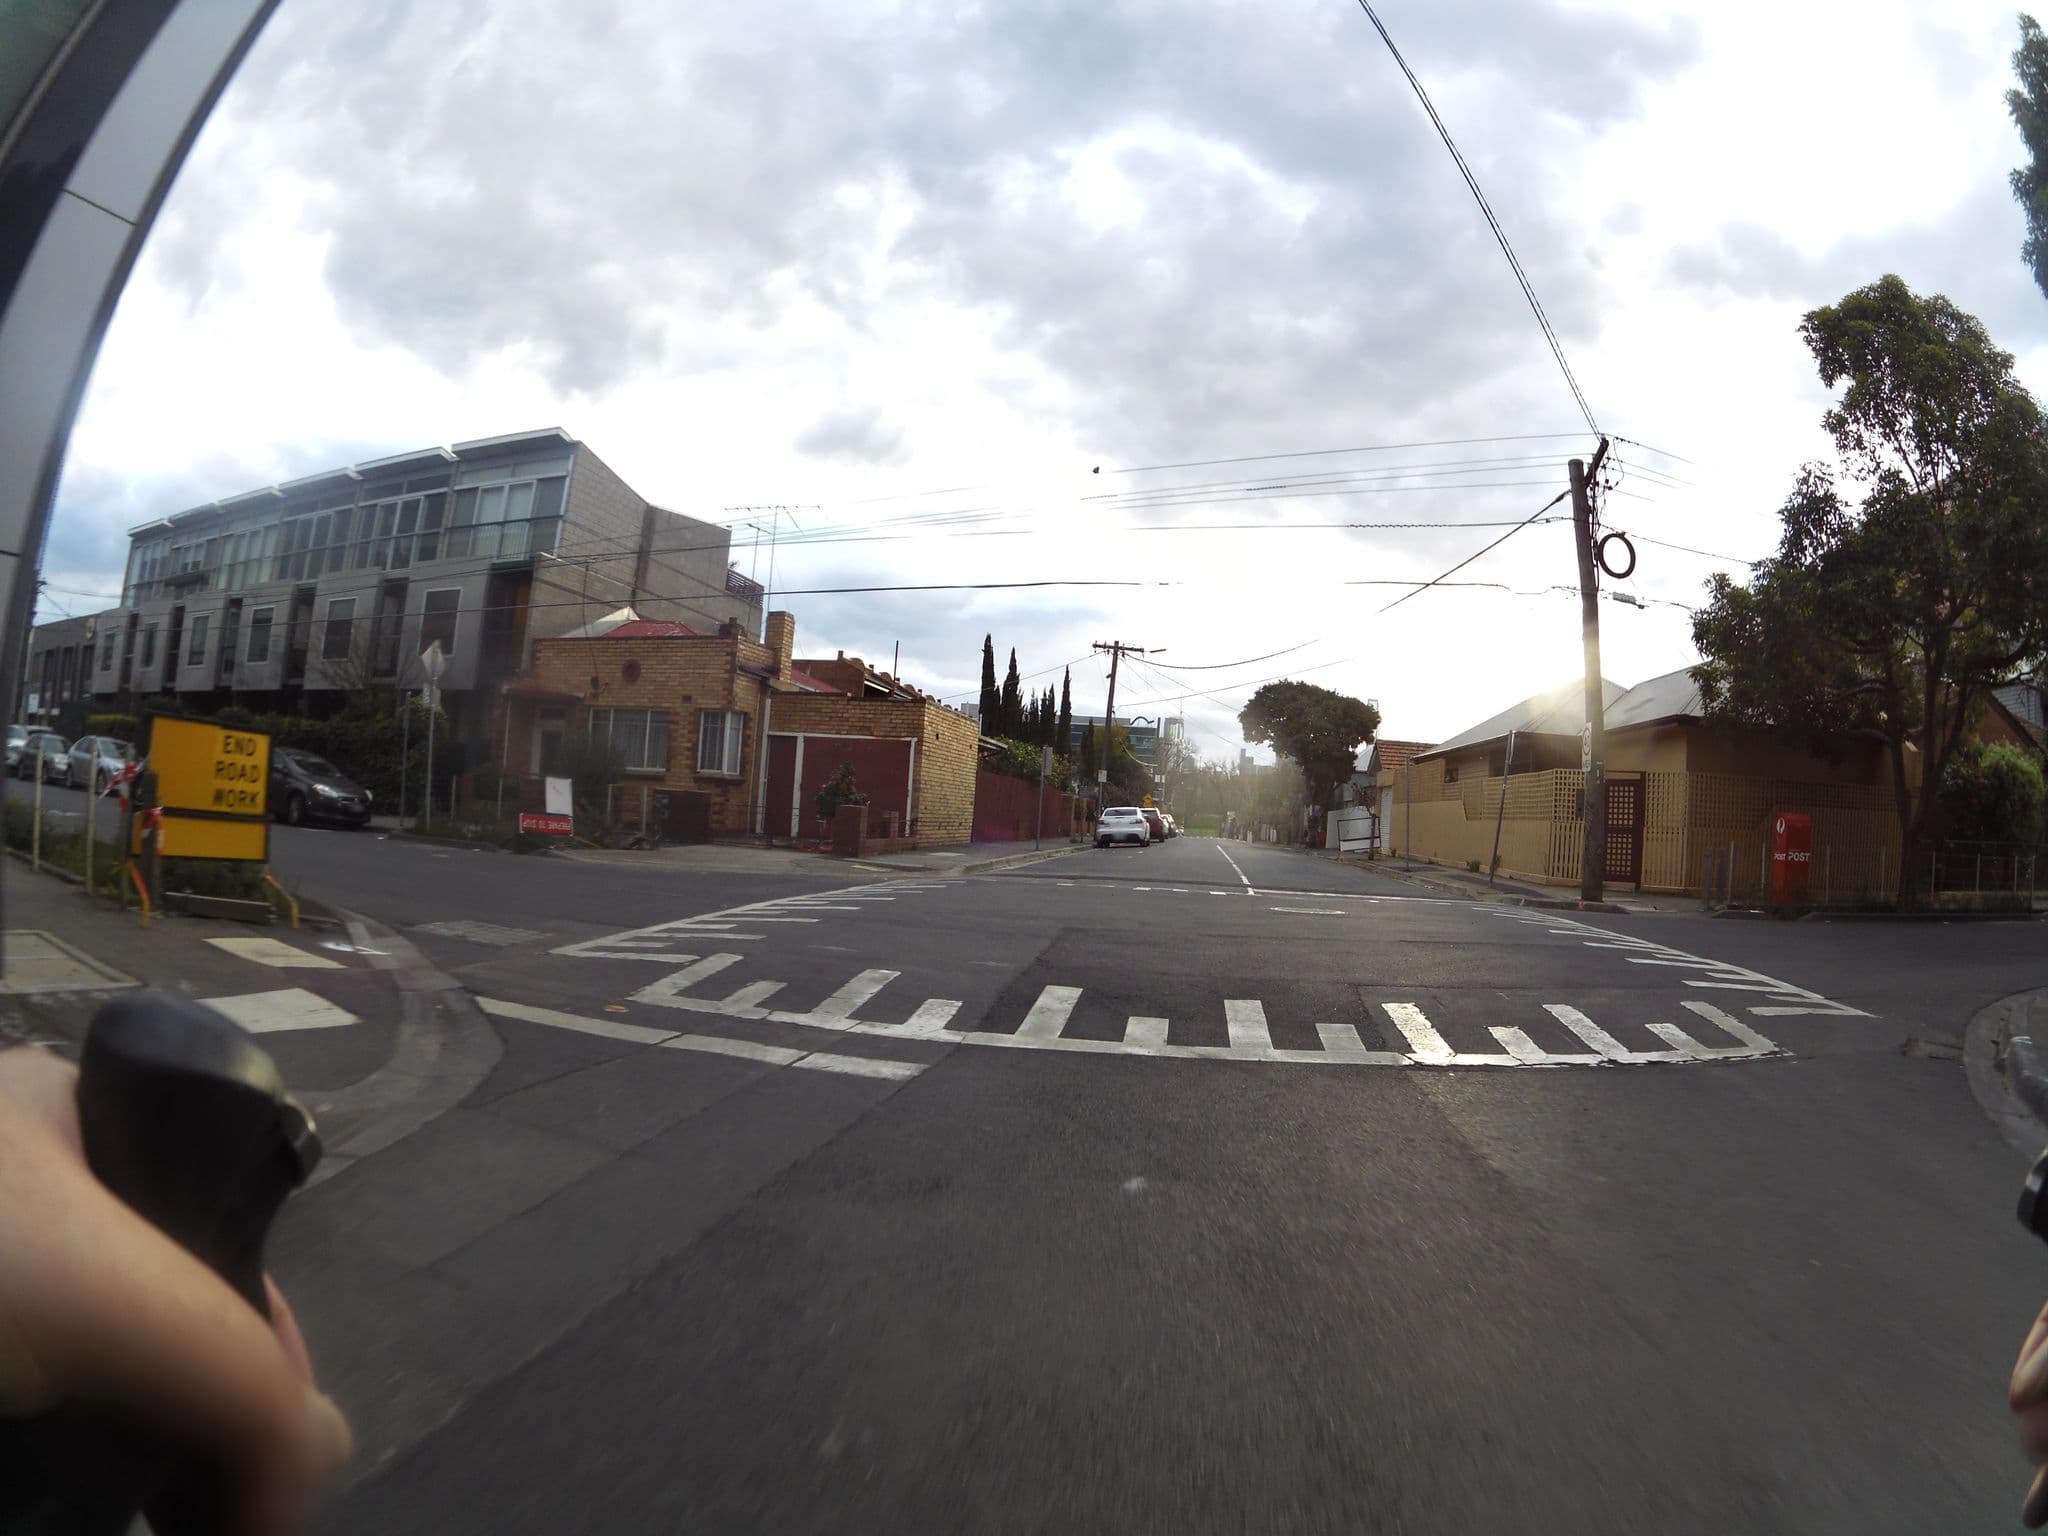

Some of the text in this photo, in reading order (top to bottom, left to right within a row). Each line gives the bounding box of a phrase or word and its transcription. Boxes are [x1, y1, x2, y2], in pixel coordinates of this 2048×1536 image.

[223, 735, 257, 757] END
[215, 760, 260, 784] ROAD
[213, 788, 260, 809] WORK
[1788, 851, 1811, 862] POST
